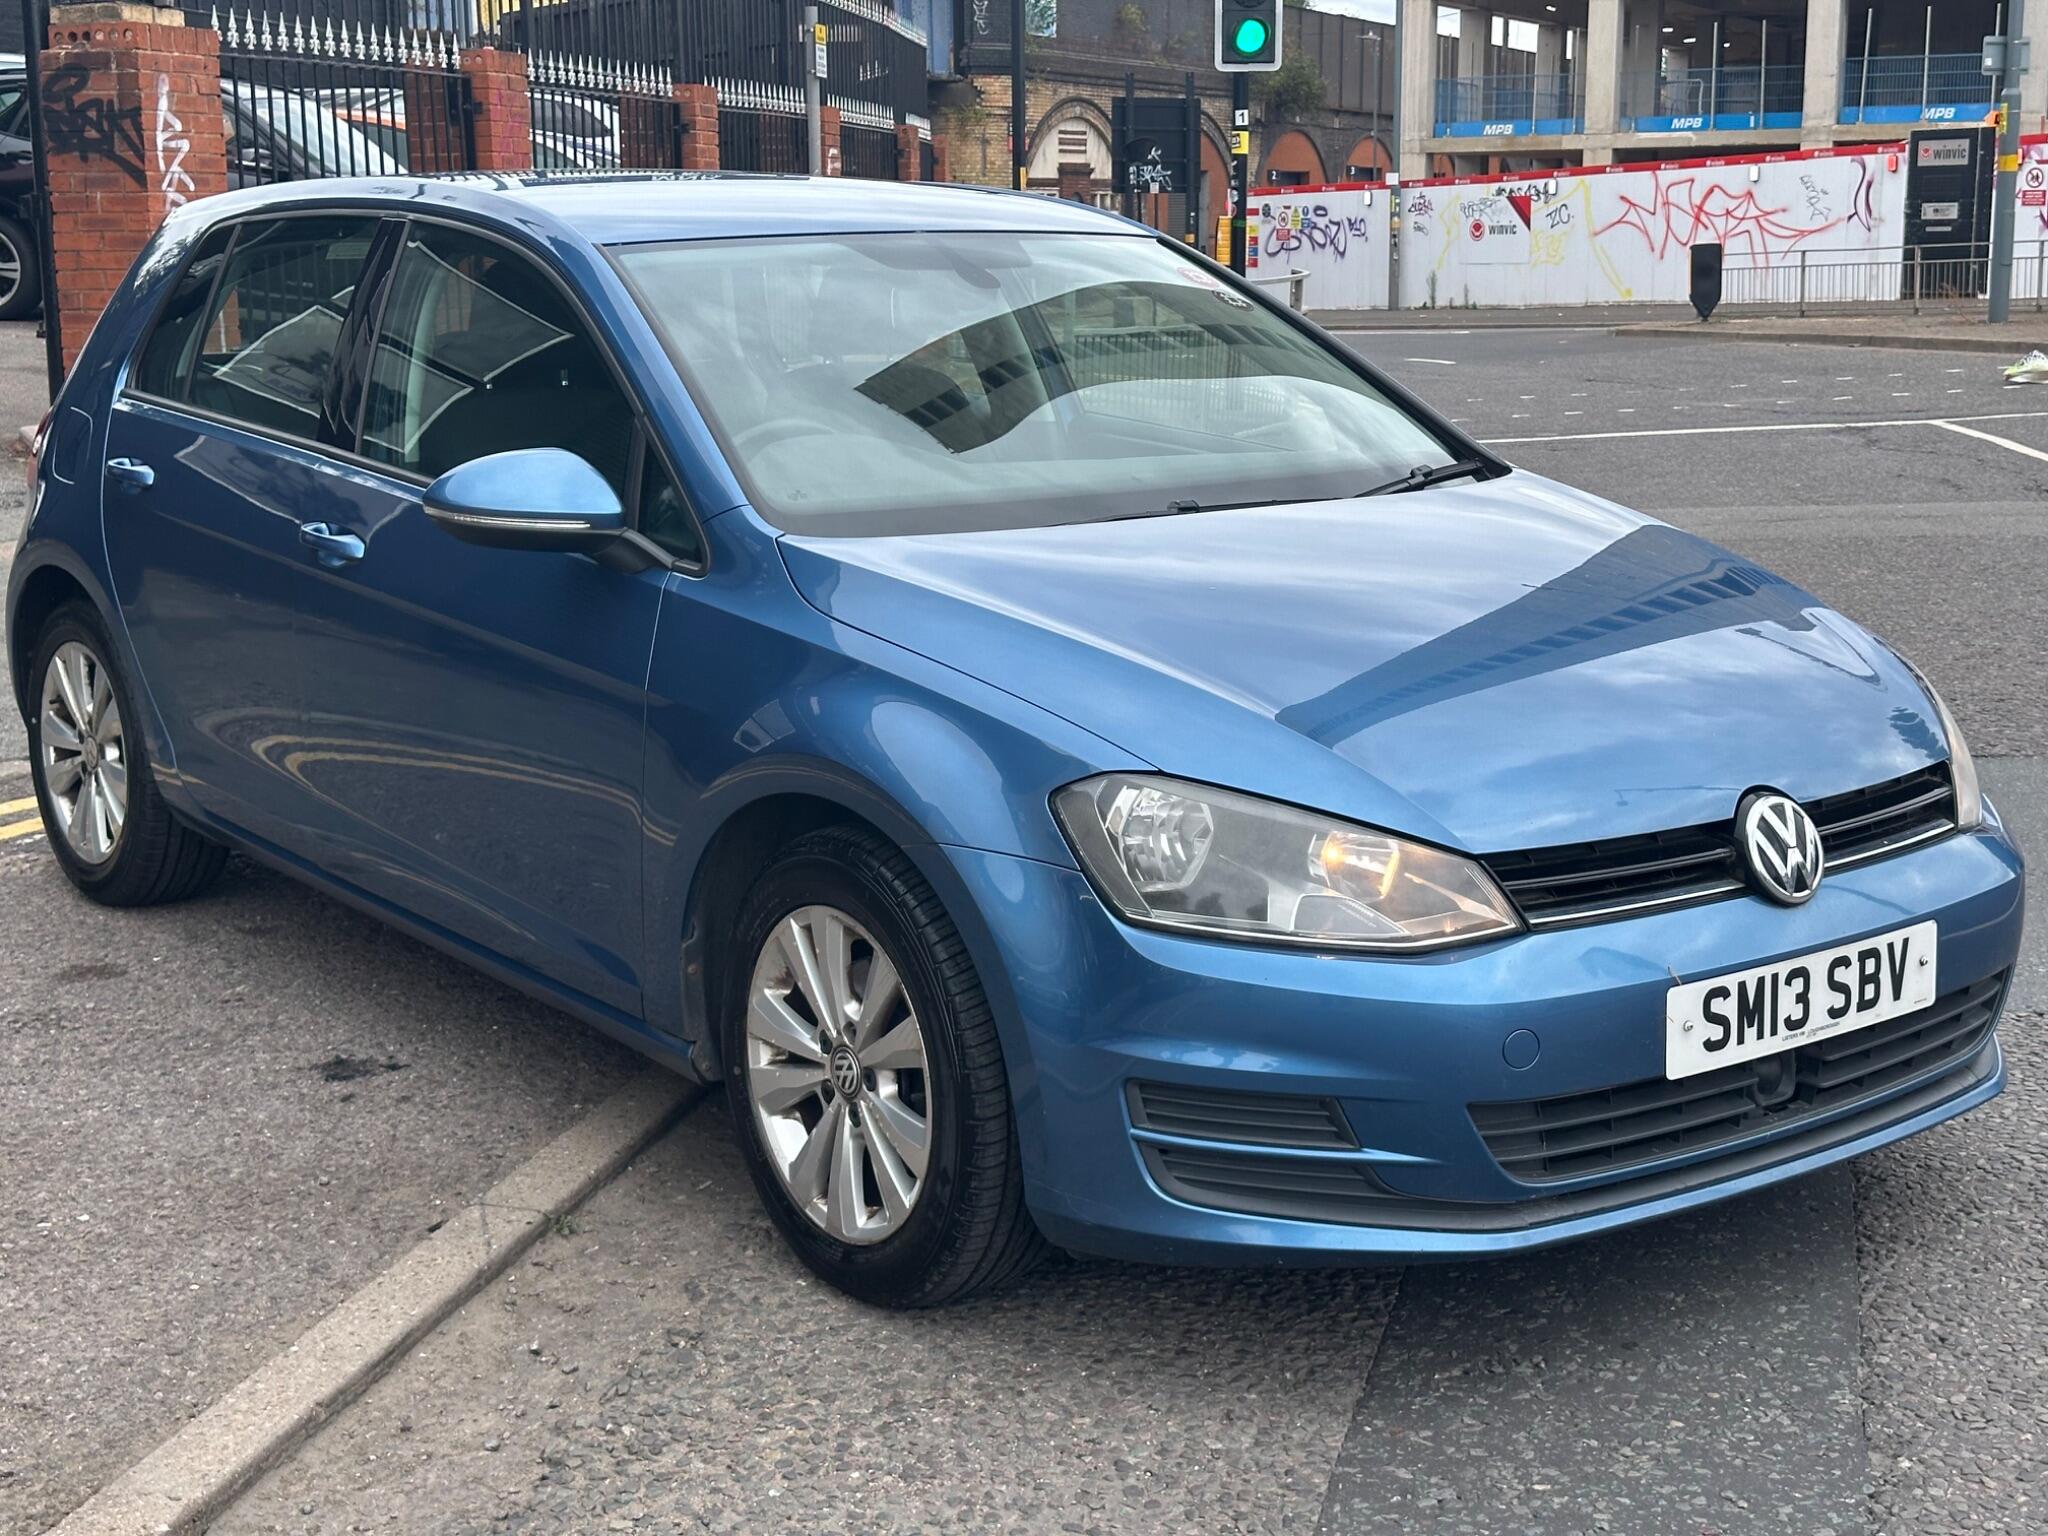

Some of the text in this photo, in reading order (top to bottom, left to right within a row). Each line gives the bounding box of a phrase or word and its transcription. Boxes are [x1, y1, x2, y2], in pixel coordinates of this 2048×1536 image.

[1238, 112, 1245, 124] 1
[1671, 117, 1703, 128] MPB
[1483, 124, 1513, 135] MPB
[1933, 144, 1967, 160] winvic
[1488, 220, 1518, 235] winvic
[1702, 937, 1909, 1052] SM13 SBV
